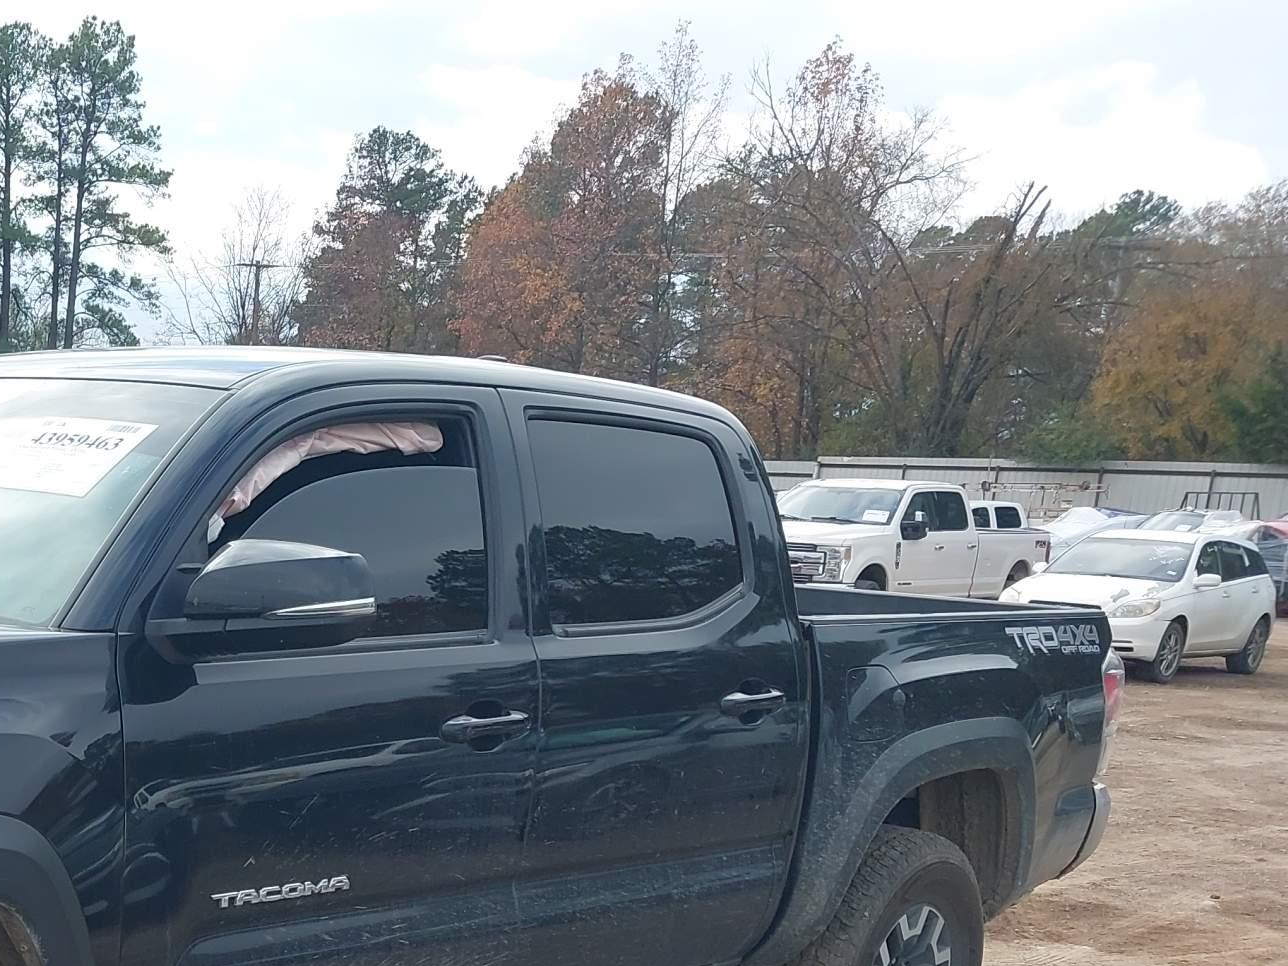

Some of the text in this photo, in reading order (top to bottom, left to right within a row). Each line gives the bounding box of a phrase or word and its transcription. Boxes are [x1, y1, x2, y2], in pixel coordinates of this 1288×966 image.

[31, 431, 124, 451] 43959463
[1004, 626, 1059, 655] TRD
[1061, 645, 1100, 654] OFF ROAD
[210, 874, 351, 908] TACOMA
